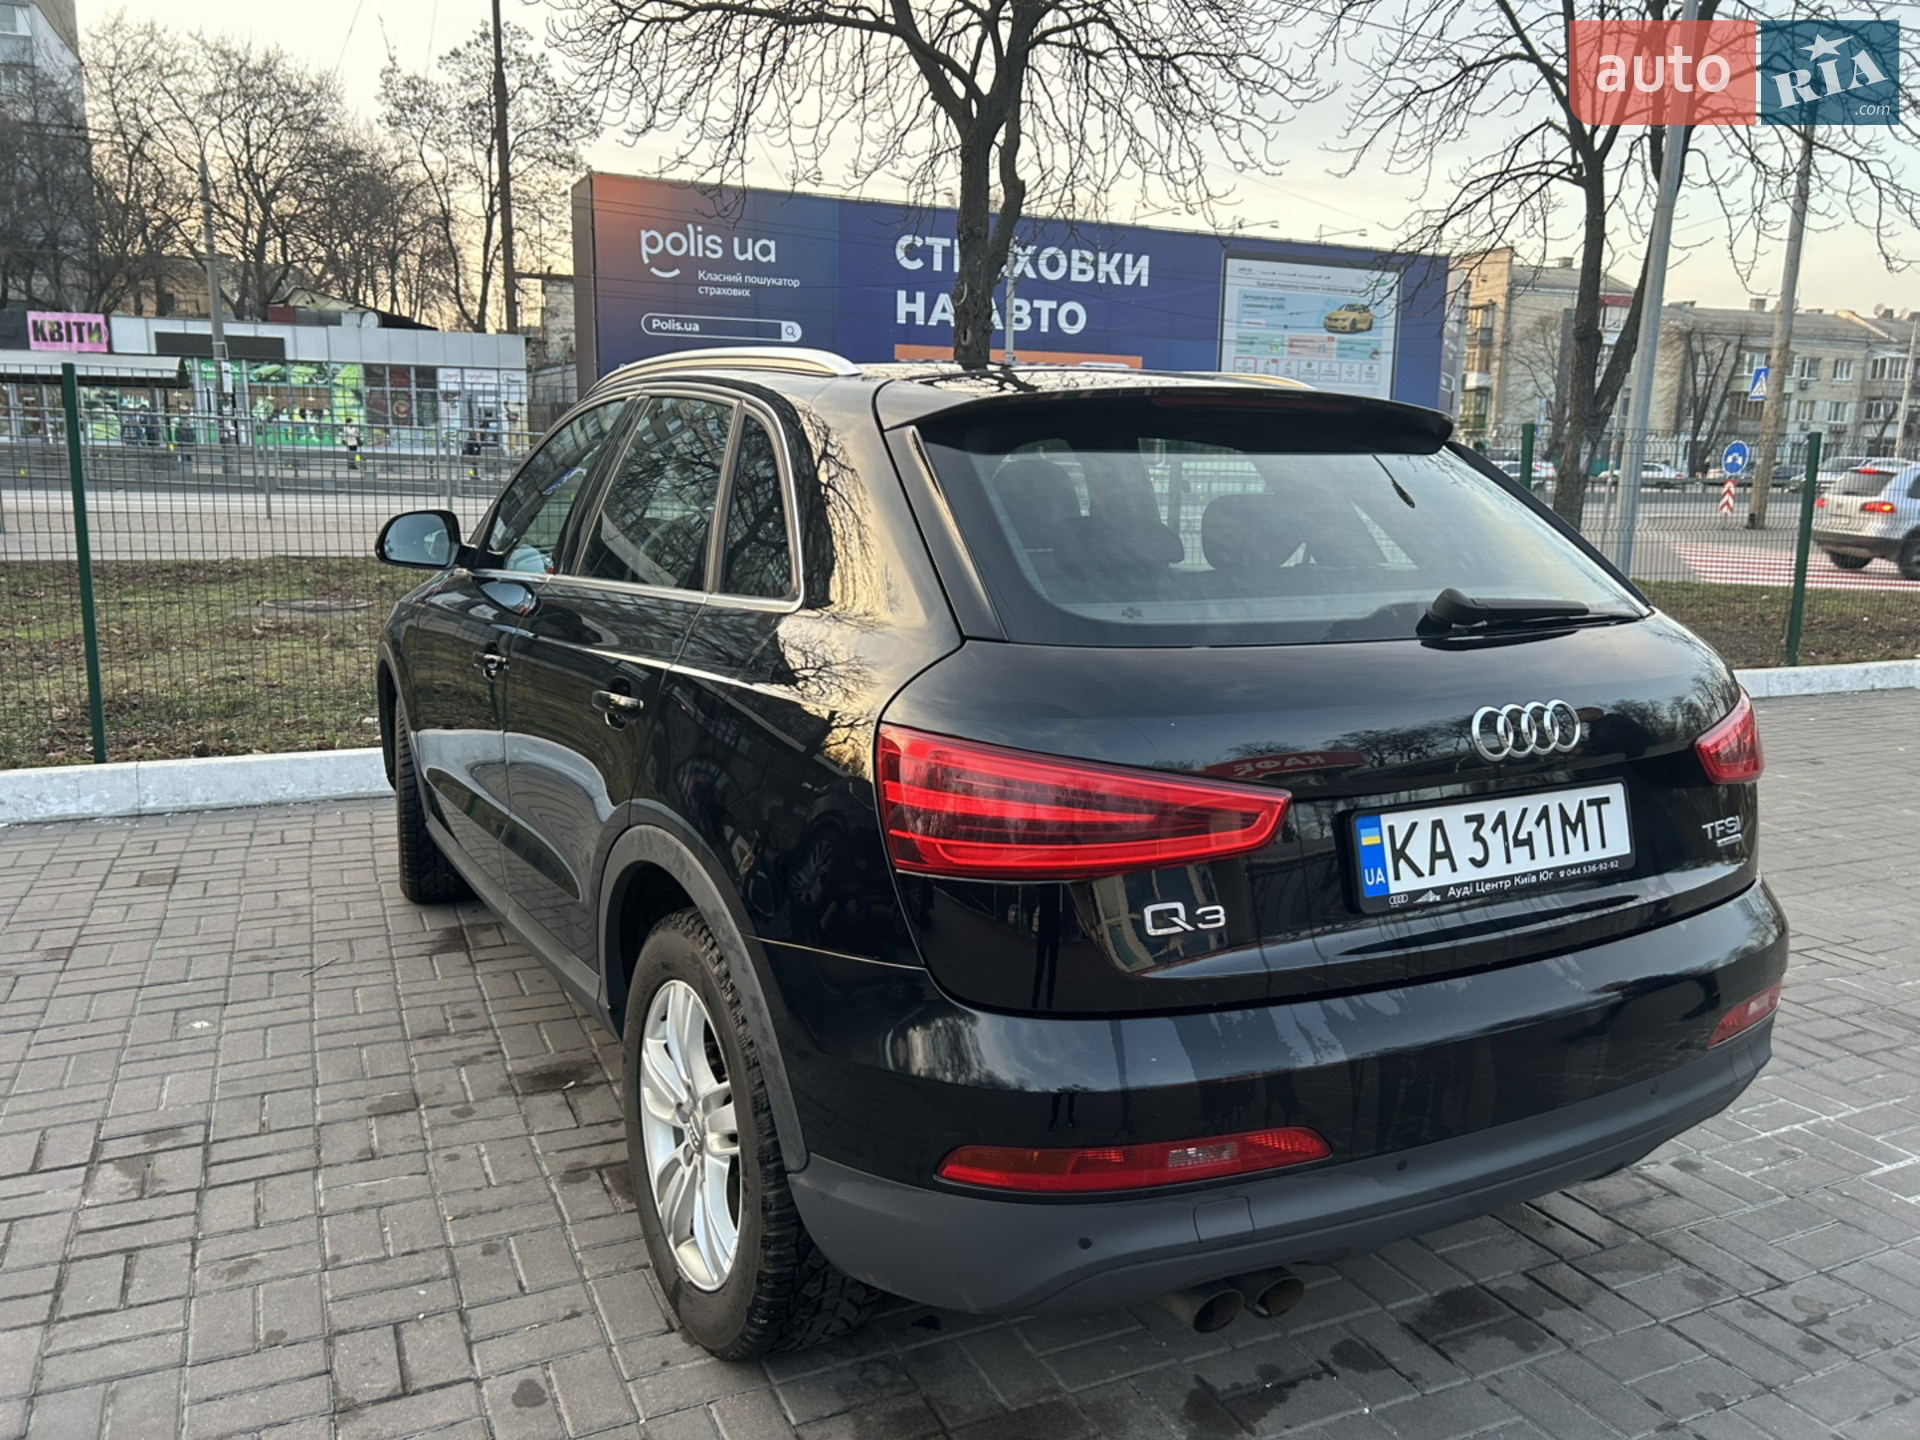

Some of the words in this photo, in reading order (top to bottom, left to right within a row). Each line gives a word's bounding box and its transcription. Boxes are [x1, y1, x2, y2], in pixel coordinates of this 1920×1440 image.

[640, 223, 724, 265] polis
[733, 236, 777, 263] ua
[895, 234, 1150, 288] СТХОВКИ
[698, 270, 743, 284] Класний
[744, 275, 801, 289] пошукатор
[698, 286, 751, 297] страхових
[31, 319, 104, 345] КВІТИ
[651, 318, 700, 332] Polis.ua
[1701, 815, 1741, 840] TFSI
[1364, 866, 1386, 886] UA
[1447, 883, 1474, 898] Ауді
[1475, 878, 1512, 893] Центр
[1513, 873, 1538, 887] Київ
[1539, 869, 1555, 881] Юг
[1566, 866, 1581, 877] 044
[1143, 901, 1227, 937] Q3
